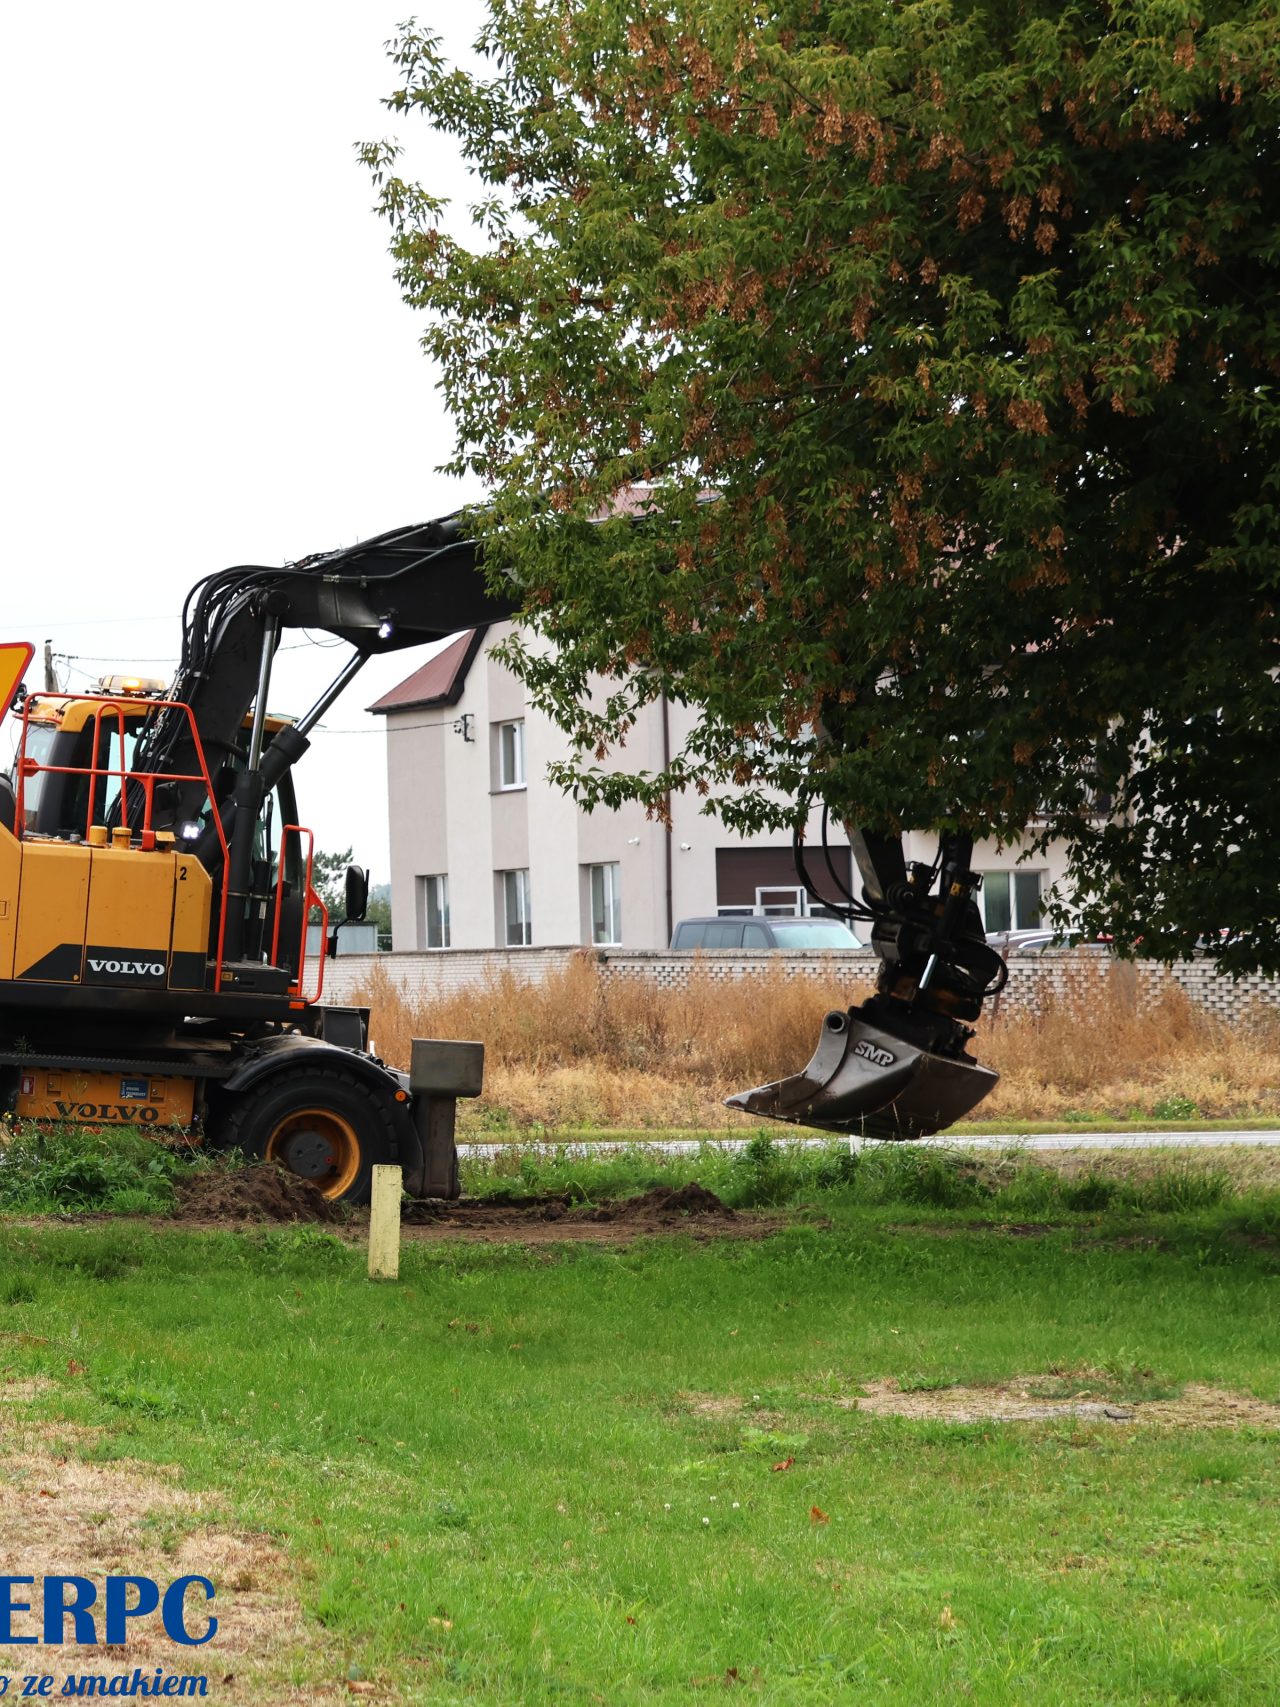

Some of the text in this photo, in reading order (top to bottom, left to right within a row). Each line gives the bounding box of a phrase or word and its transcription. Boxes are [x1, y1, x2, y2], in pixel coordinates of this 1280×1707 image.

[179, 866, 188, 881] 2
[87, 959, 166, 976] VOLVO
[854, 1041, 894, 1066] SMP
[53, 1101, 159, 1122] VOLVO
